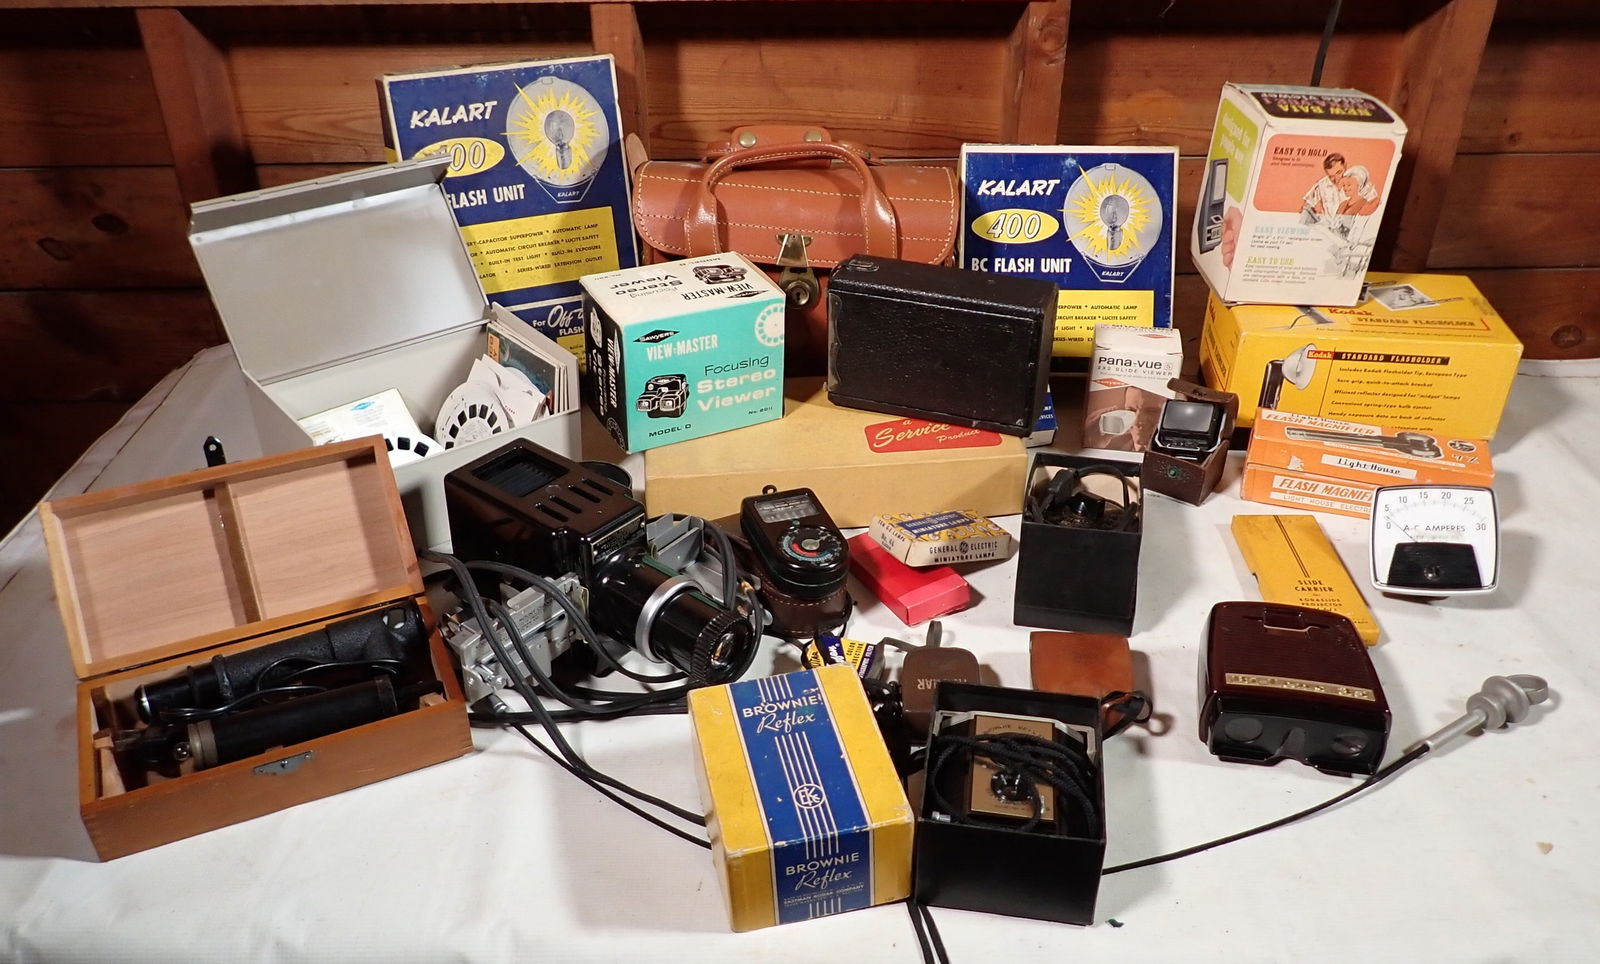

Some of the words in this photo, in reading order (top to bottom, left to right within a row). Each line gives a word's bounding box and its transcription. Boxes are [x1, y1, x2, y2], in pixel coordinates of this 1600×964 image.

[410, 100, 498, 128] KALART
[439, 141, 486, 171] 00
[1273, 146, 1294, 155] EASY
[1297, 148, 1307, 156] TO
[1308, 149, 1328, 157] HOLD
[493, 184, 525, 202] UNIT
[557, 190, 580, 198] KALART
[977, 179, 1061, 196] KALART
[509, 231, 544, 240] SUPERPOWER
[552, 226, 582, 234] AUTOMATIC
[987, 213, 1042, 239] 400
[1255, 226, 1273, 234] EASY
[485, 246, 516, 255] AUTOMATIC
[538, 240, 560, 248] BREAKER
[488, 258, 511, 266] BUILT-IN
[575, 245, 601, 253] EXPOSURE
[517, 264, 551, 273] SERIES-WIRED
[554, 259, 582, 268] EXTENSION
[585, 255, 603, 263] OUTLET
[971, 258, 988, 272] BC
[994, 258, 1034, 273] FLASH
[1040, 258, 1072, 273] UNIT
[1248, 256, 1267, 264] EASY
[1269, 257, 1278, 265] TO
[609, 274, 678, 290] Viewer
[615, 280, 684, 296] Stereo
[683, 283, 754, 301] VIEW-MASTER
[1328, 308, 1374, 316] Kodak
[1357, 317, 1409, 325] STANDARD
[1413, 319, 1475, 327] FLASHOLDER
[646, 334, 718, 361] VIEW-MASTER
[1098, 356, 1162, 370] Pana-vue
[1307, 350, 1333, 359] Kodak
[1341, 353, 1385, 362] STANDARD
[1390, 356, 1442, 364] FLASHOLDER
[606, 338, 618, 408] VIEW-MASTER
[705, 355, 769, 376] Focusing
[697, 368, 776, 394] Stereo
[697, 386, 776, 411] Viewer
[648, 426, 682, 438] MODEL
[1266, 414, 1303, 425] FLASH
[1308, 419, 1375, 434] MAGNIFIER
[873, 423, 952, 448] Service
[936, 429, 981, 444] Product
[1279, 479, 1319, 492] FLASH
[1283, 495, 1305, 504] LIGHT
[1309, 498, 1335, 508] HOUSE
[1385, 504, 1390, 512] 5
[1399, 496, 1408, 504] 10
[1419, 491, 1429, 499] 15
[1441, 491, 1452, 499] 20
[1464, 497, 1474, 505] 25
[1386, 522, 1392, 530] 0
[1476, 523, 1487, 531] 30
[929, 545, 957, 554] GENERAL
[971, 541, 998, 550] ELECTRIC
[934, 553, 972, 562] MINIATURE
[846, 642, 856, 656] COLOR
[851, 643, 864, 669] RRECTION
[866, 645, 875, 661] FILTER
[742, 695, 818, 718] BROWNIE
[756, 712, 816, 734] Reflex
[785, 852, 860, 876] BROWNIE
[795, 868, 853, 890] Reflex
[784, 896, 812, 905] EASTMAN
[836, 884, 864, 894] COMPANY
